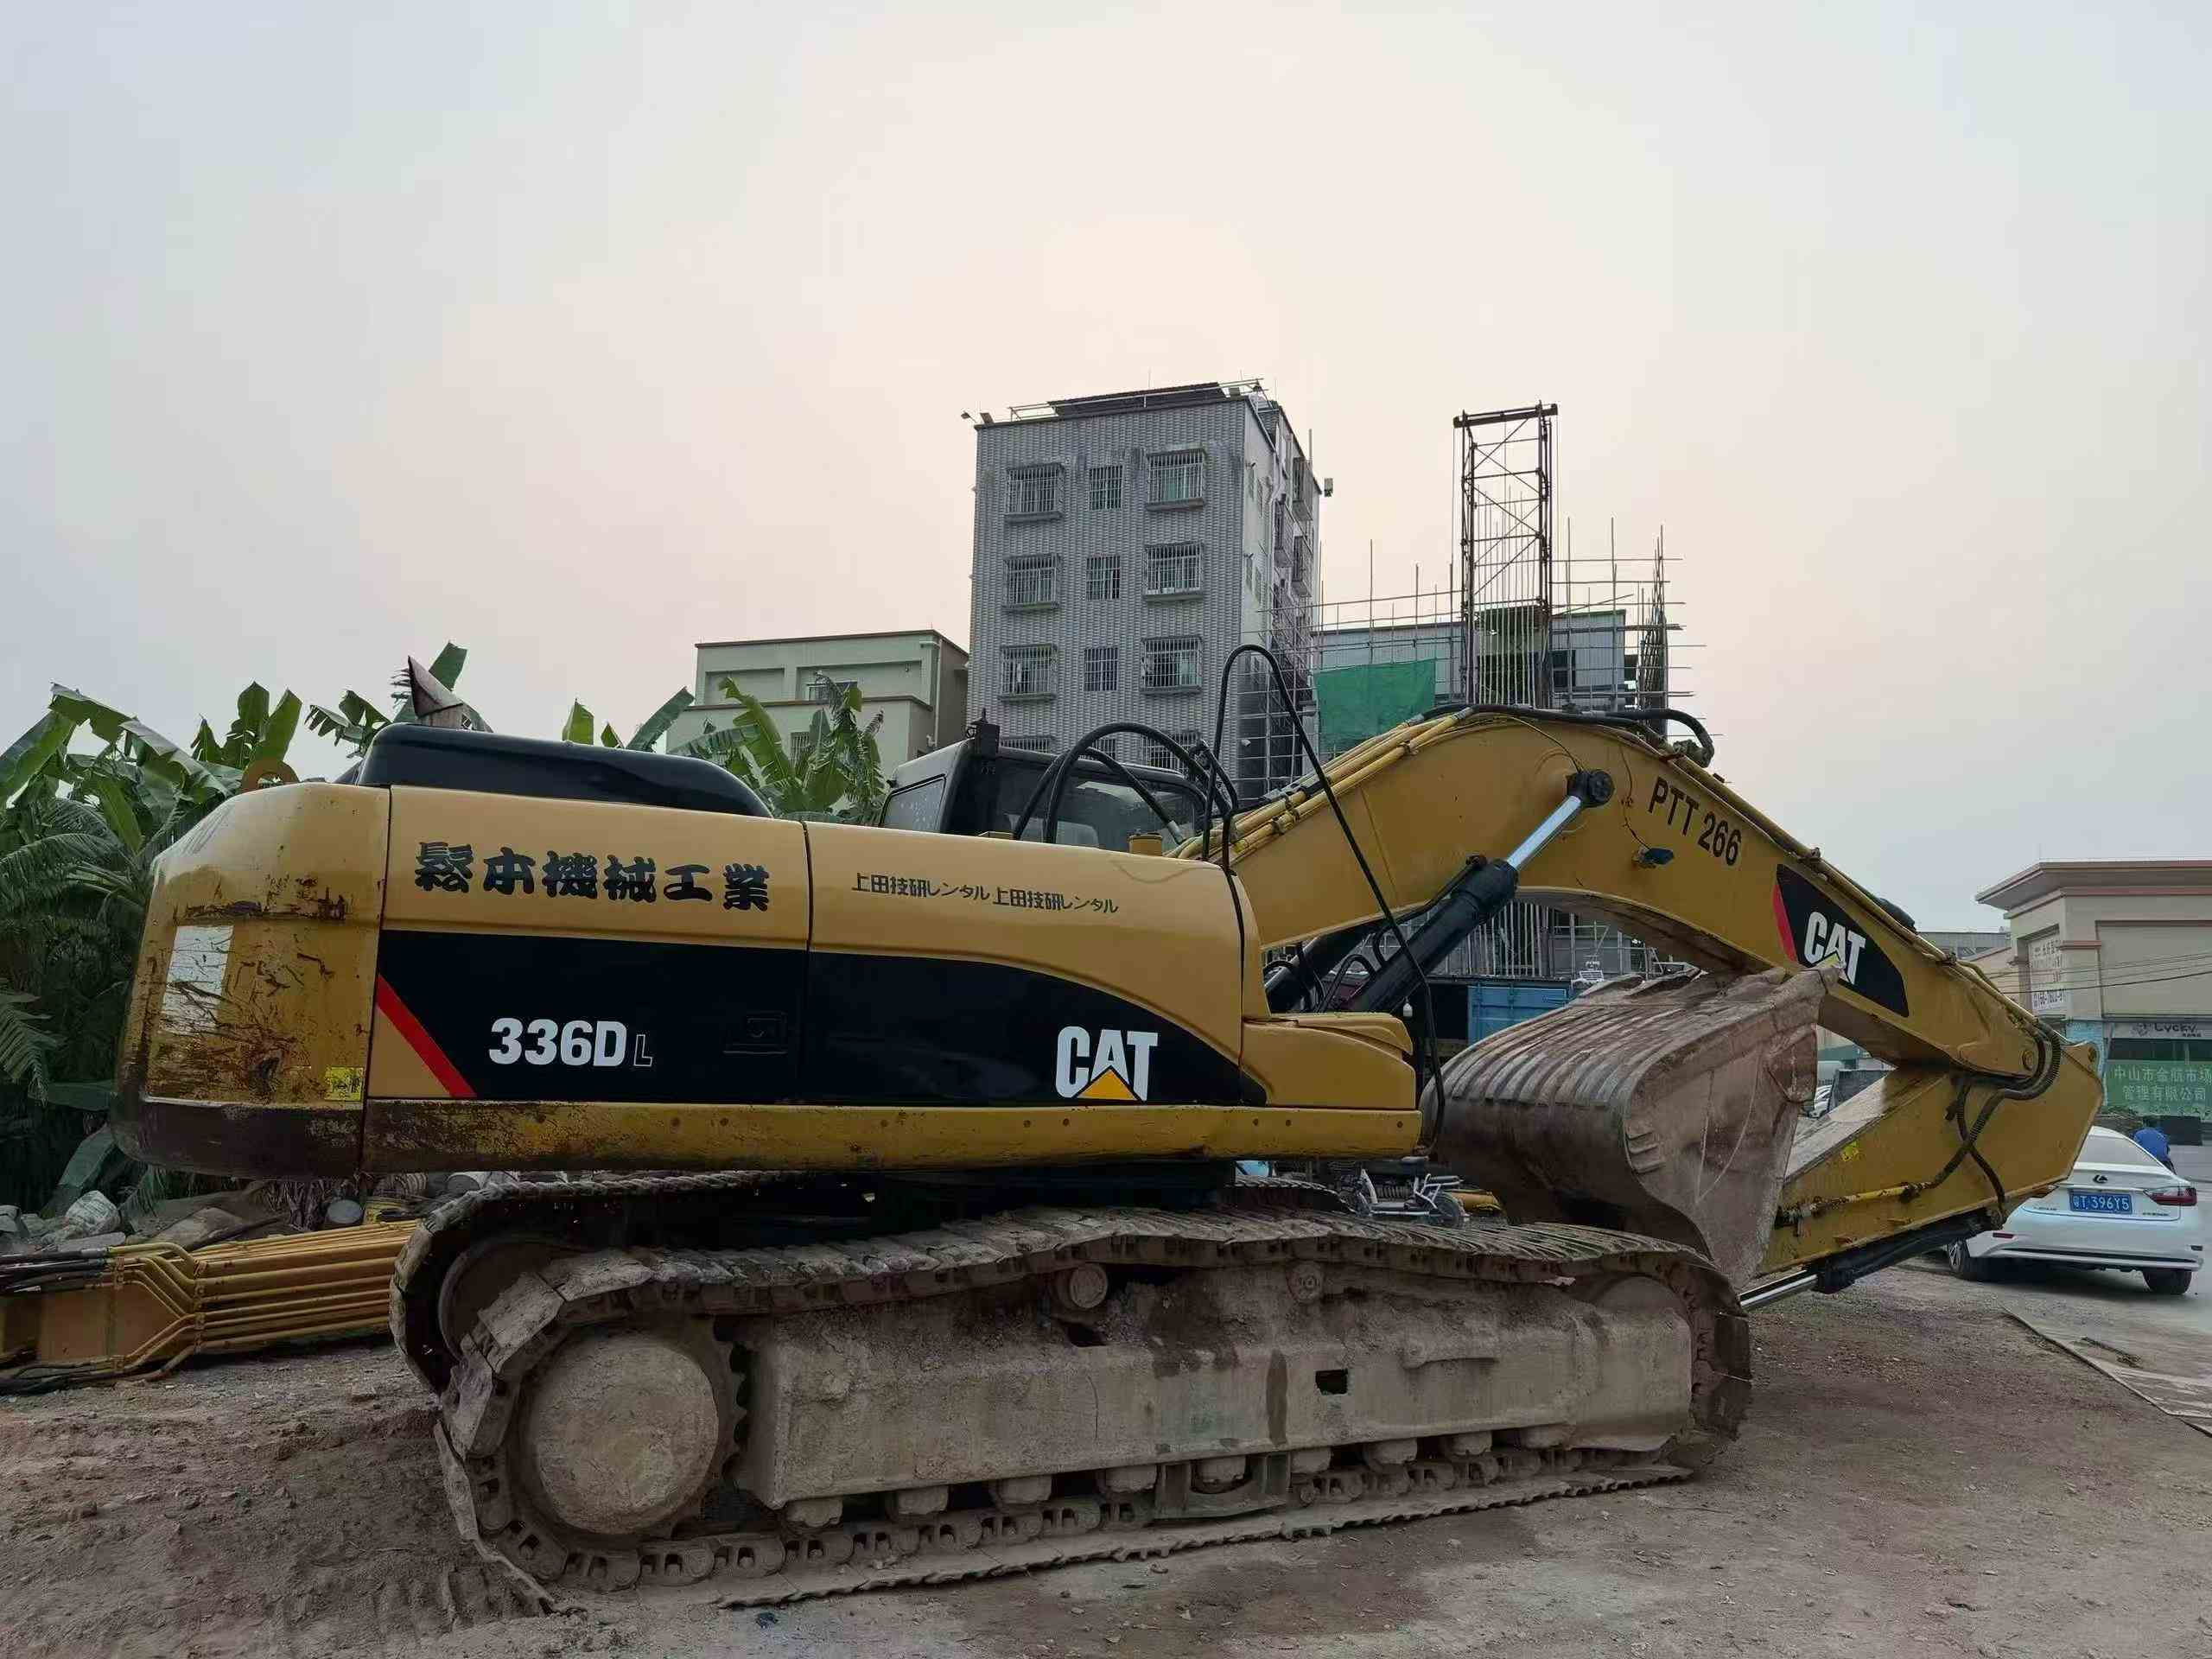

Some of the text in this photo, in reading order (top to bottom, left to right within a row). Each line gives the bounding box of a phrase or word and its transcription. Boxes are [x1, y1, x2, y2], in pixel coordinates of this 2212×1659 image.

[1648, 776, 1742, 866] PTT 266
[852, 873, 1119, 913] 上田技研レンタル 上田技研レンタル
[1803, 911, 1866, 985] CAT
[488, 1017, 653, 1067] 336D L
[1055, 1026, 1159, 1102] CAT
